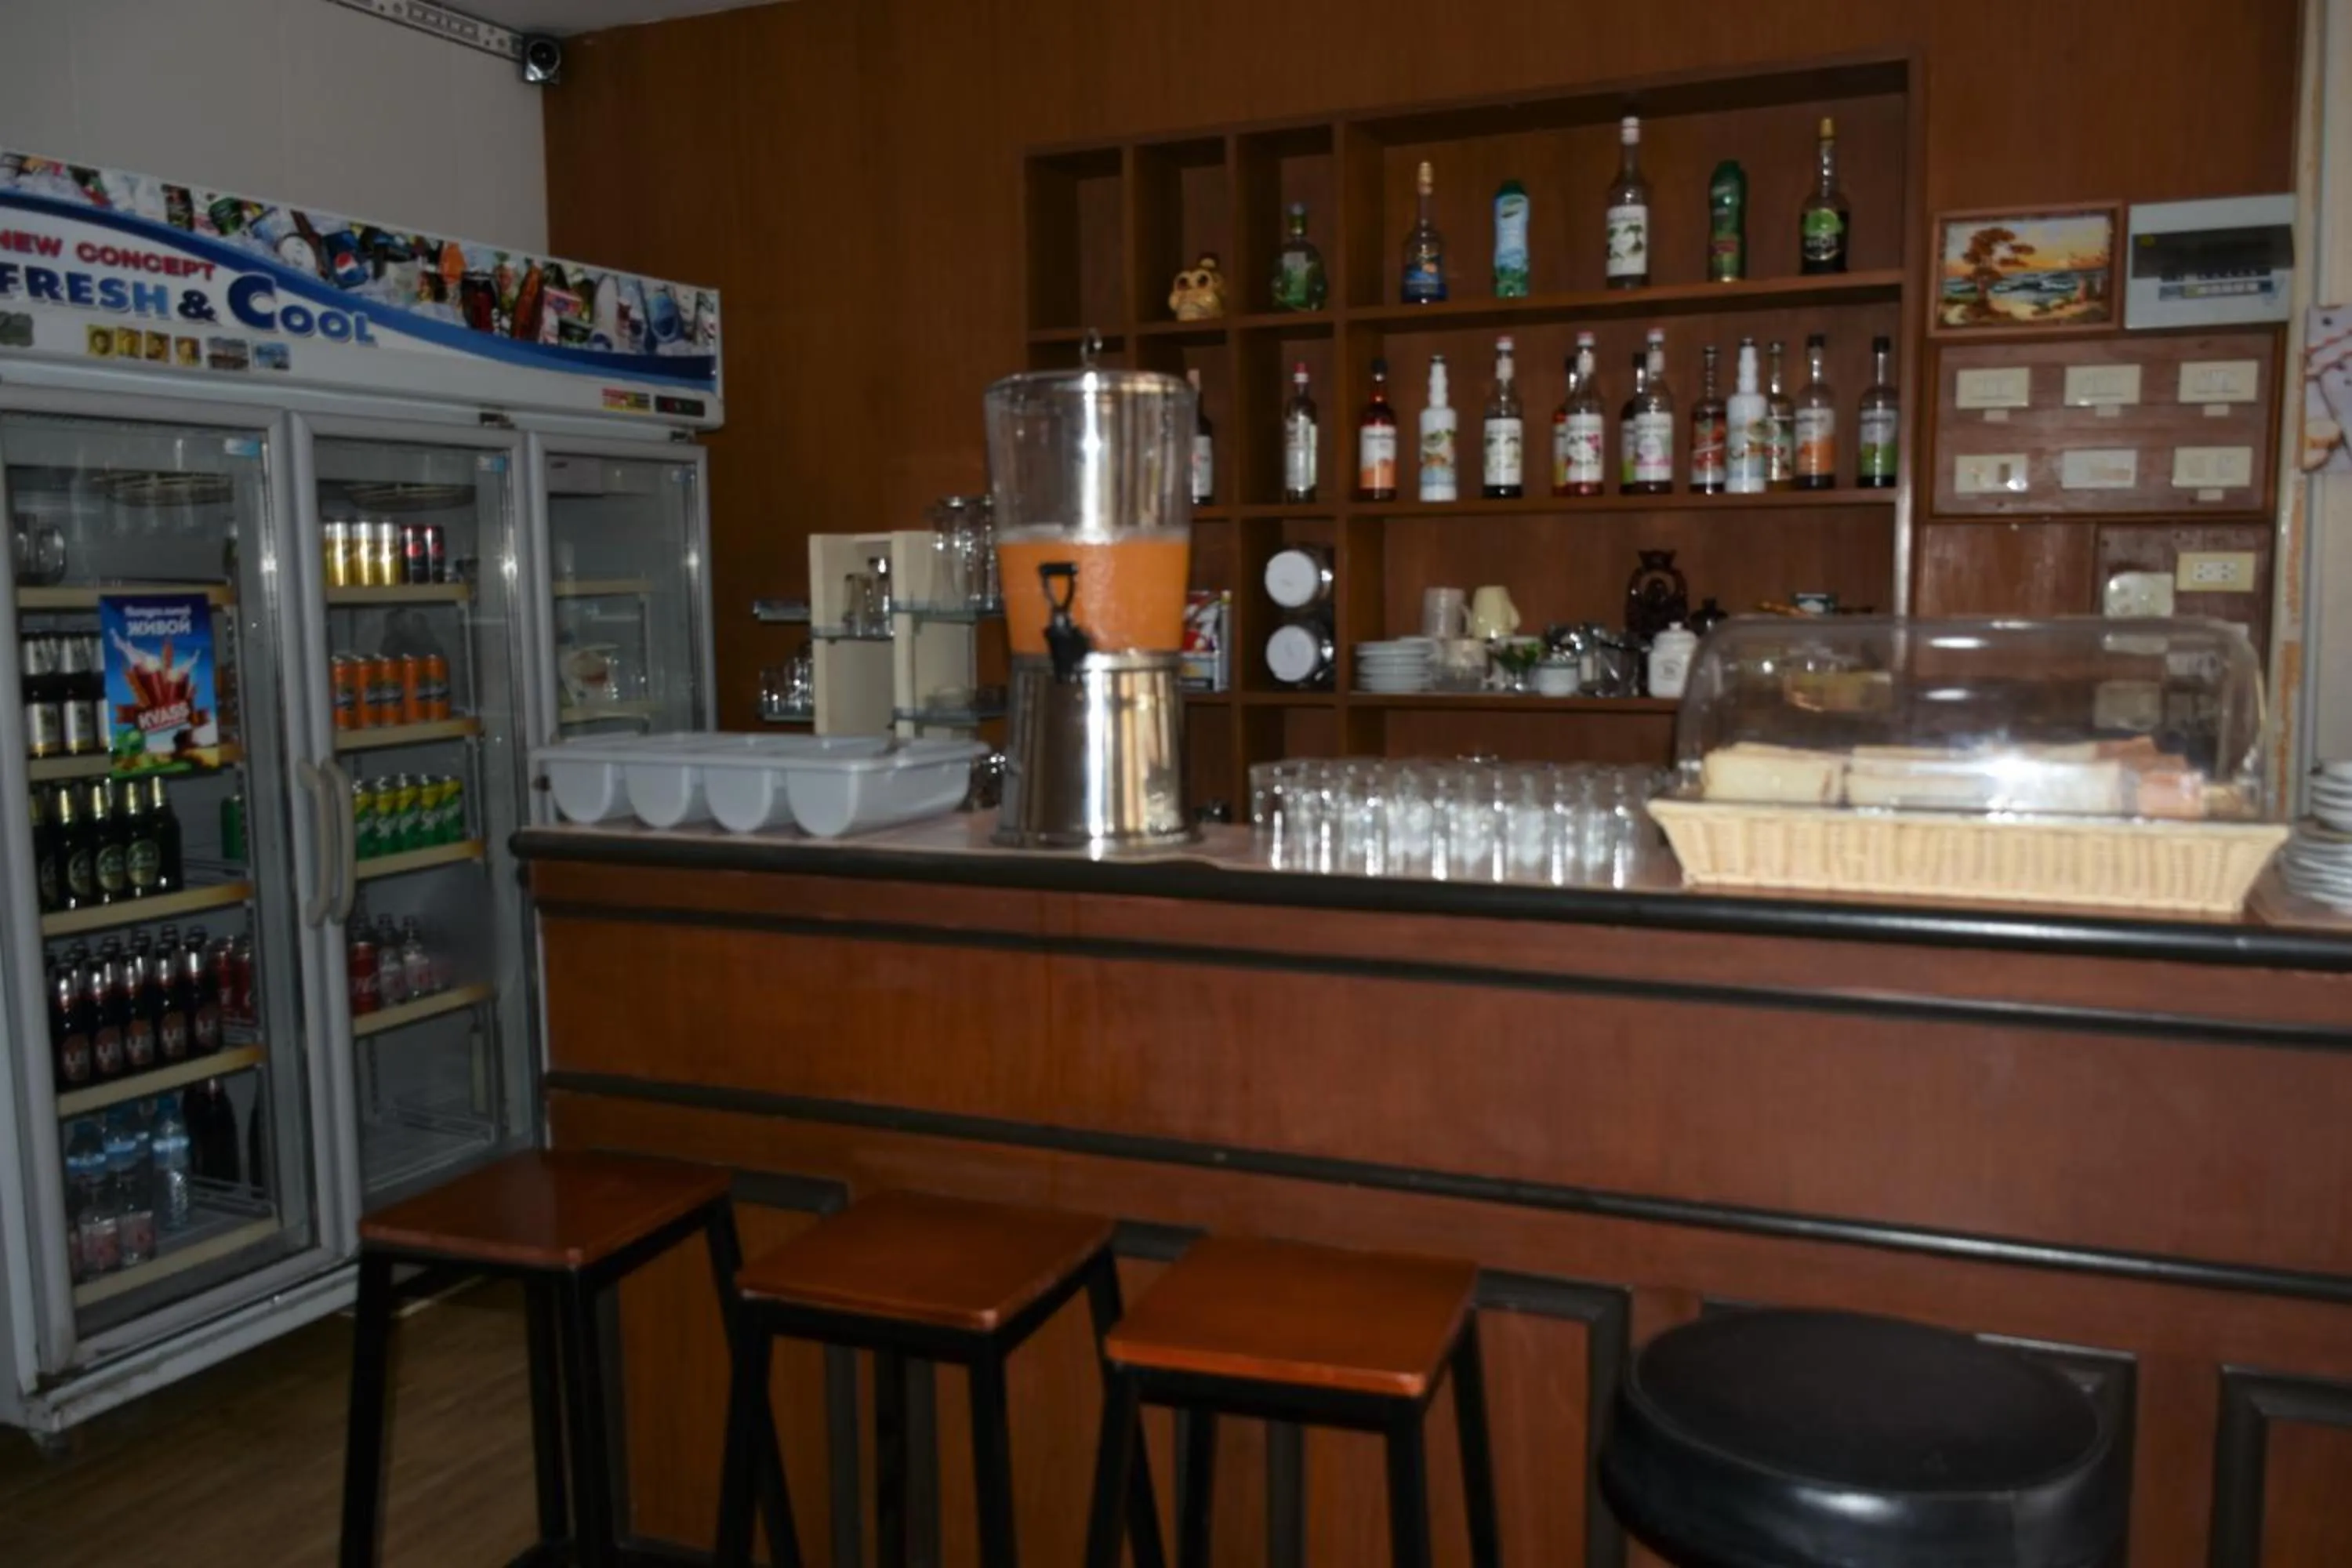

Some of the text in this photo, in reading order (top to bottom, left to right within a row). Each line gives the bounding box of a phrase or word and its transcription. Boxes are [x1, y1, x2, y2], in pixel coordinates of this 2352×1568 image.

[0, 229, 216, 280] NEW CONCEPT
[0, 263, 169, 318] FRESH
[177, 289, 217, 324] &
[138, 701, 190, 729] KVASS
